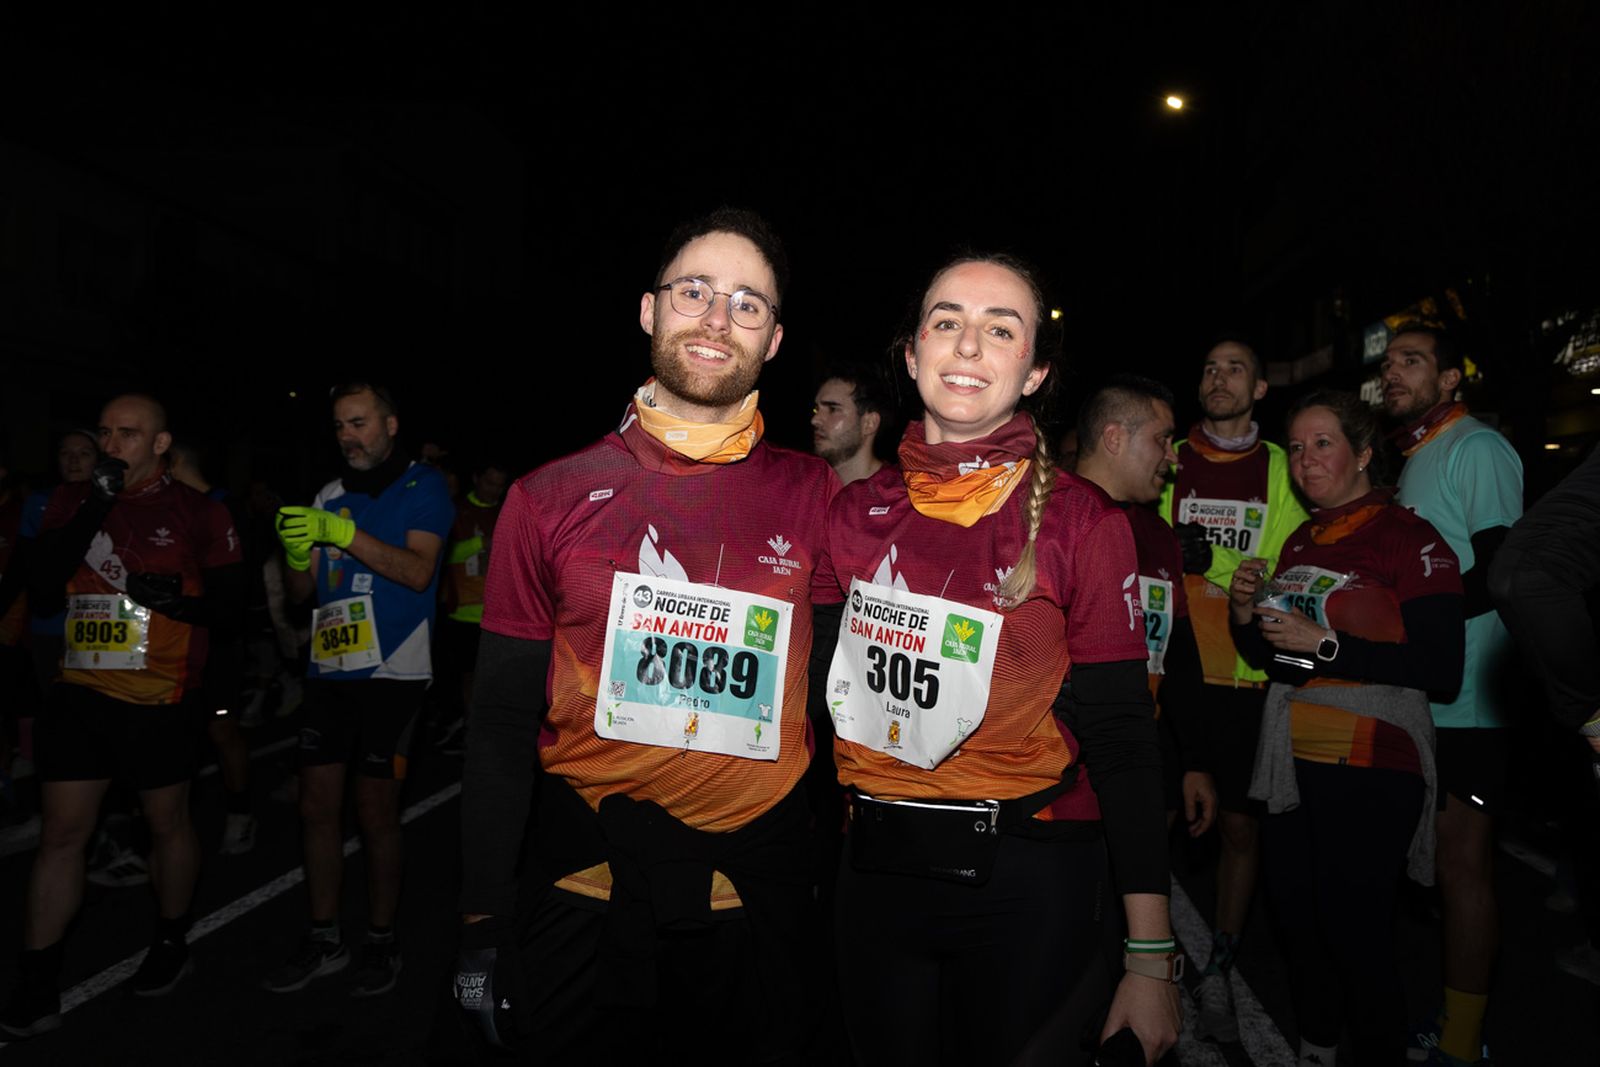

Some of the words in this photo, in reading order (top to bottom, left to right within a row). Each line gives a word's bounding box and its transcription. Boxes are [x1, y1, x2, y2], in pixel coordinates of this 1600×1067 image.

[1200, 508, 1225, 516] NOCHE
[1227, 509, 1237, 517] DE
[101, 561, 120, 580] 43
[654, 597, 708, 619] NOCHE
[710, 606, 731, 623] DE
[656, 590, 677, 598] CARRERA
[678, 593, 696, 601] URBANA
[697, 596, 731, 607] INTERNACIONAL
[631, 613, 667, 634] SAN
[669, 622, 729, 643] ANTÓN
[863, 602, 906, 626] NOCHE
[908, 613, 929, 631] DE
[75, 622, 127, 643] 8903
[321, 624, 358, 651] 3847
[850, 617, 874, 639] SAN
[875, 625, 926, 653] ANTÓN
[637, 637, 759, 699] 8089
[866, 645, 940, 710] 305
[679, 694, 710, 709] Pedro
[886, 702, 911, 719] Laura
[461, 987, 484, 998] SAN
